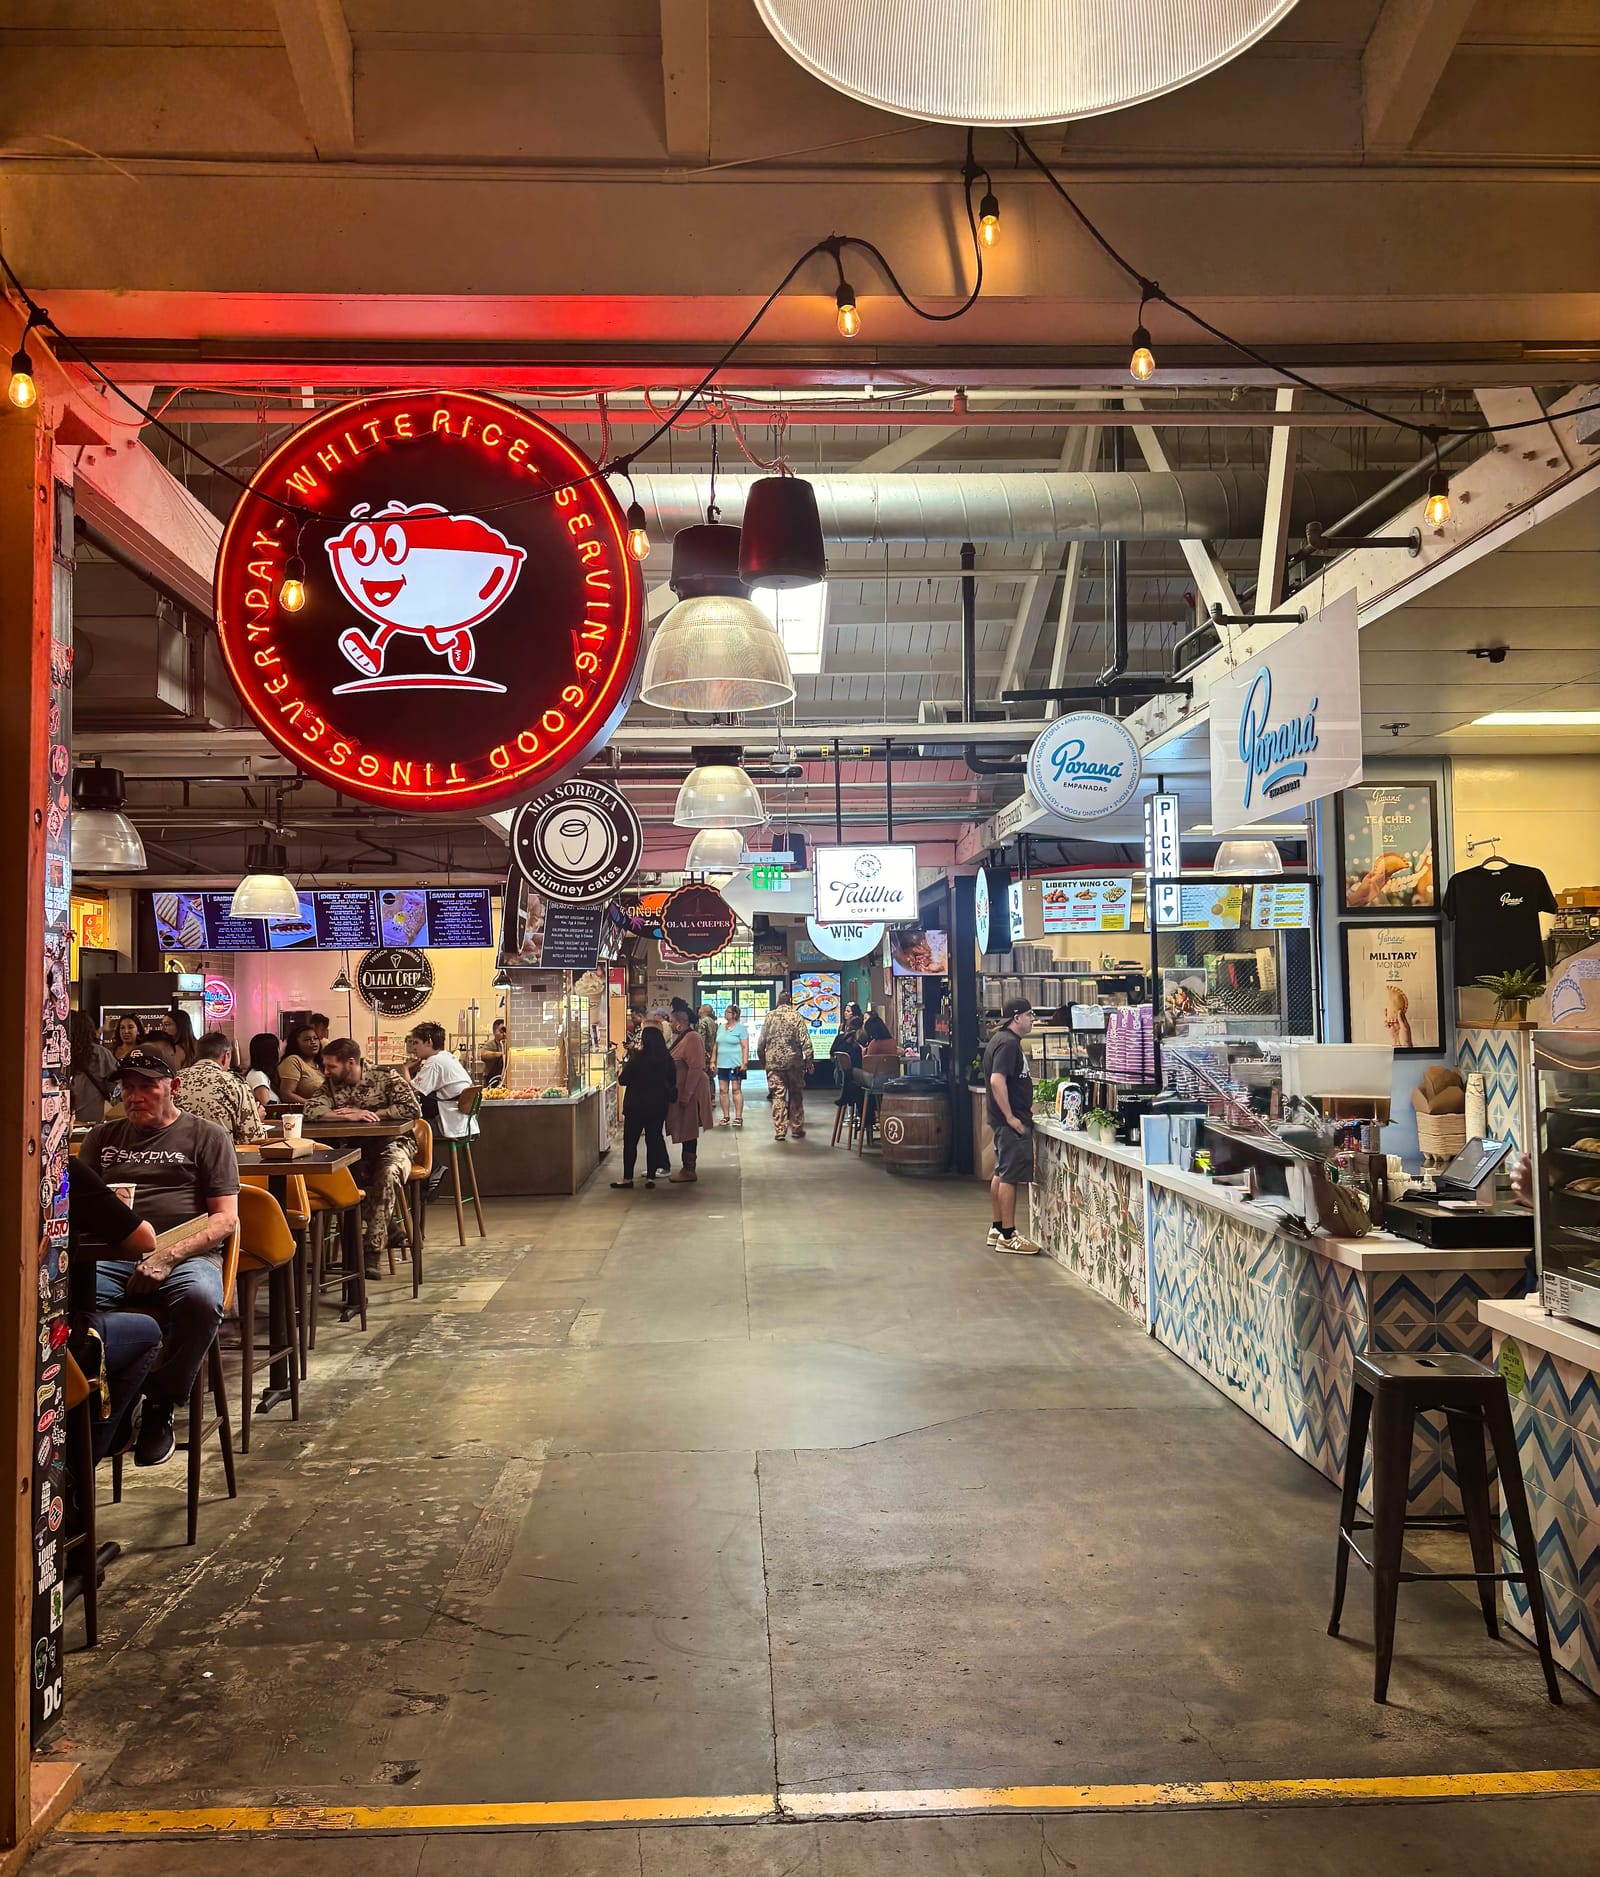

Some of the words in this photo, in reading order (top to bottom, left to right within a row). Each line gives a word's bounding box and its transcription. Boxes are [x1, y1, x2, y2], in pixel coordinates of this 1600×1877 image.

[285, 413, 414, 496] WHITE
[553, 485, 611, 676] SERVING
[489, 685, 585, 770] GOOD
[1064, 715, 1092, 725] AMAZING
[1092, 715, 1110, 725] FOOD
[1113, 723, 1127, 738] TASTY
[1238, 665, 1319, 808] Paraná
[328, 743, 467, 788] TINGS
[1051, 738, 1124, 782] Paraná
[1063, 781, 1108, 793] EMPANADAS
[527, 792, 555, 817] MIA
[555, 784, 618, 813] SORELLA
[1364, 815, 1412, 824] TEACHER
[1383, 835, 1394, 843] $2
[532, 868, 584, 896] chimney
[587, 865, 622, 892] cakes
[752, 866, 784, 890] EXIT
[829, 880, 904, 907] Talitha
[666, 921, 695, 929] OLALA
[696, 920, 731, 928] CREPES
[830, 926, 863, 939] WING
[1369, 952, 1418, 960] MILITARY
[1376, 961, 1411, 969] MONDAY
[362, 971, 393, 987] OLALA
[1388, 970, 1400, 978] $2
[118, 1150, 185, 1159] SKYDIVE
[43, 1676, 62, 1721] DC
